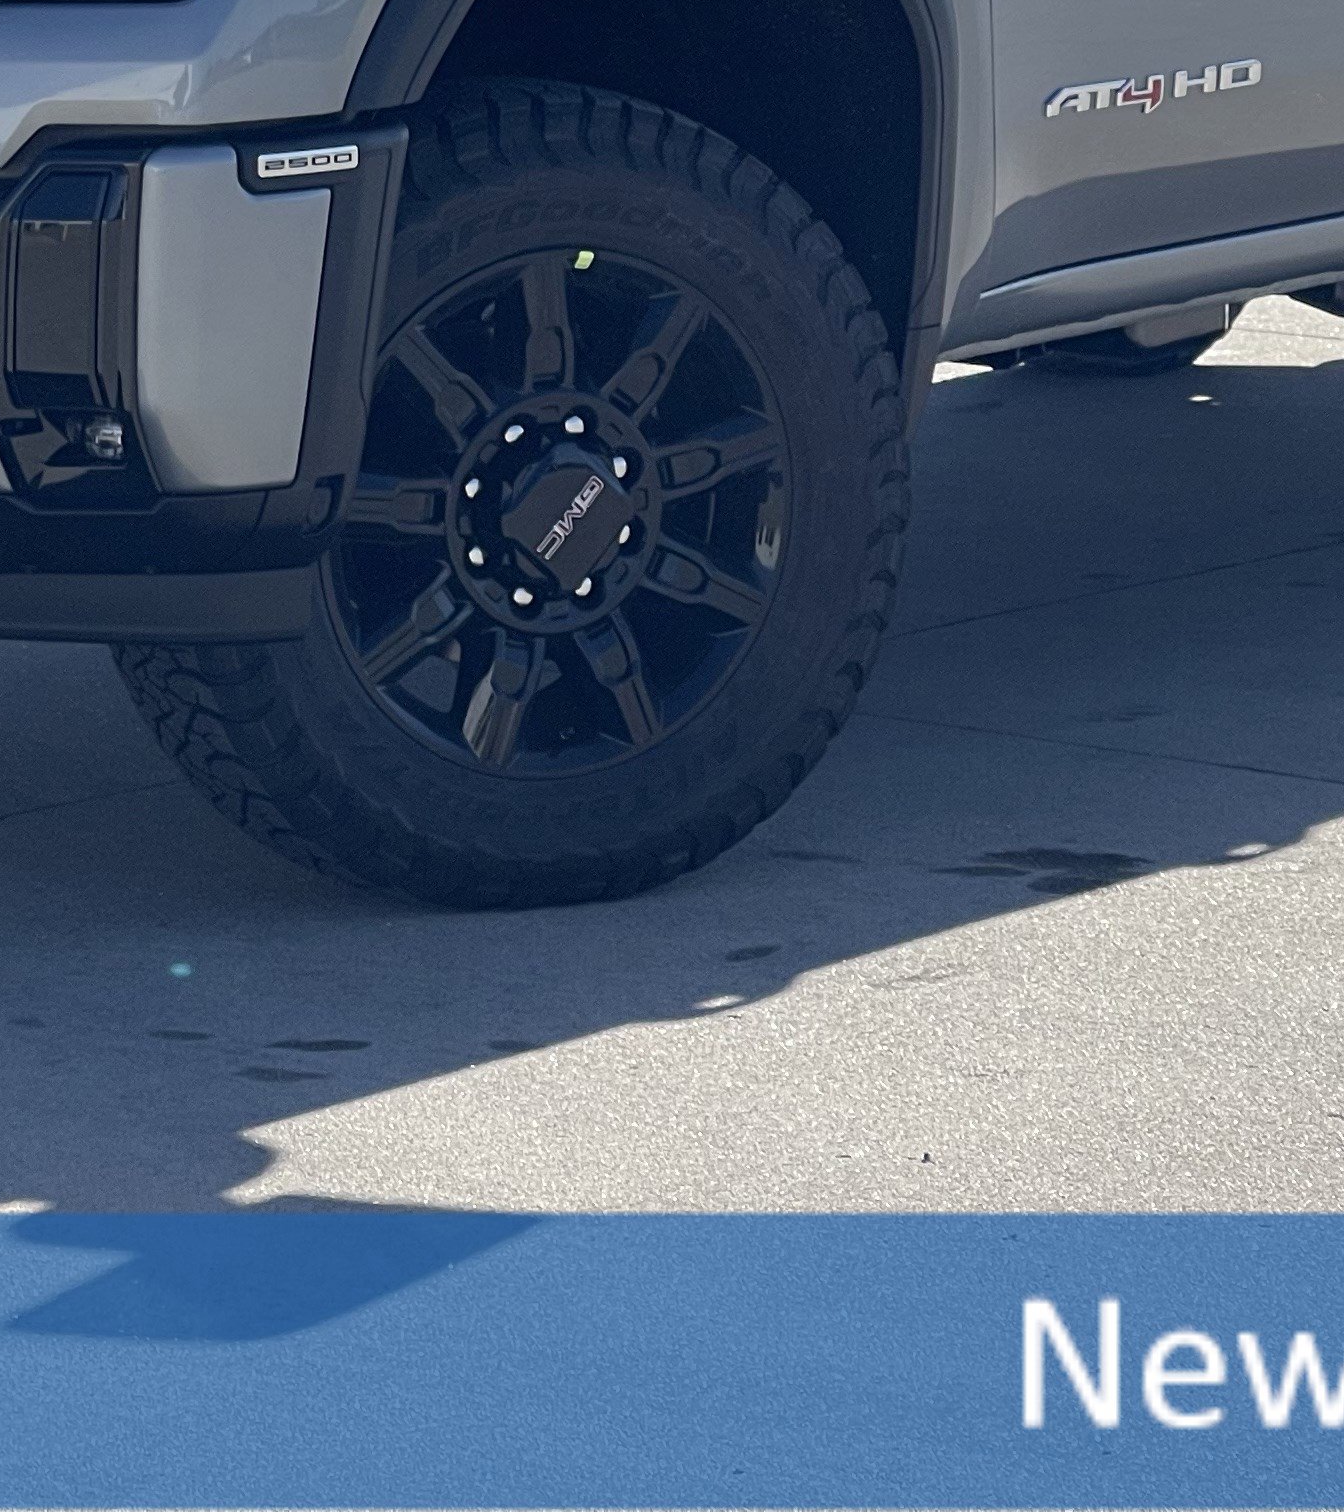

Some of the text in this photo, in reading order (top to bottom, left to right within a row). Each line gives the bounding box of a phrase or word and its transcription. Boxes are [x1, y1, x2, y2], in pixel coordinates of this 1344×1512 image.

[1044, 58, 1262, 118] AT4 HD
[264, 153, 353, 171] 2500
[536, 475, 605, 560] GMC
